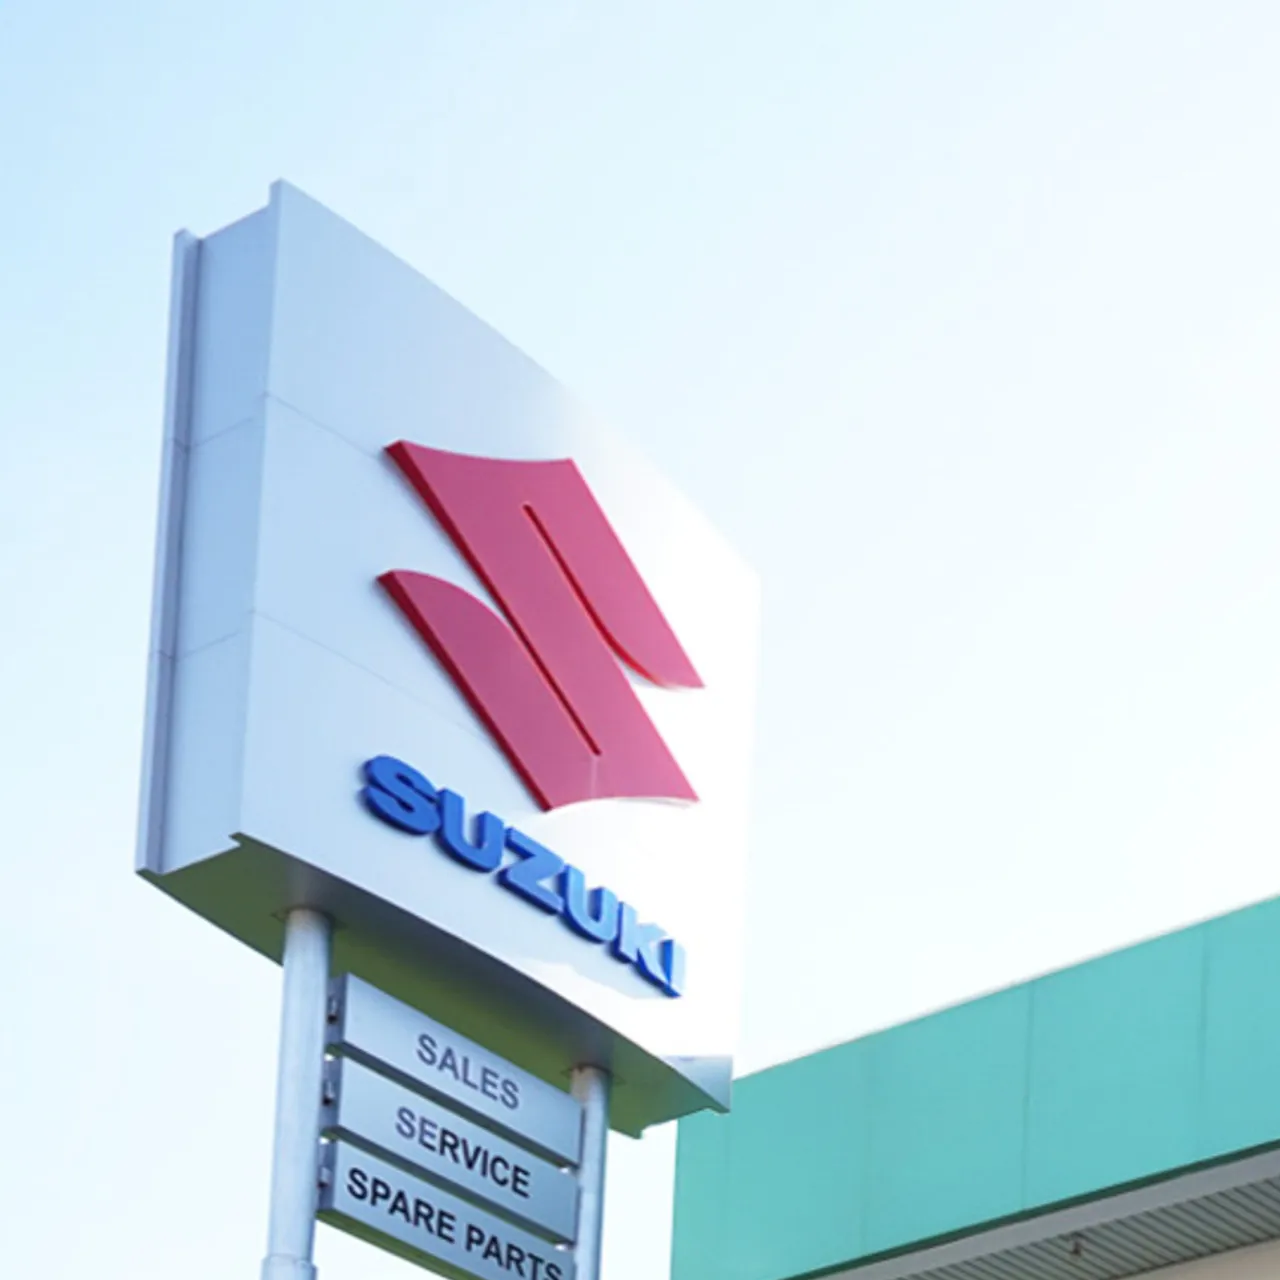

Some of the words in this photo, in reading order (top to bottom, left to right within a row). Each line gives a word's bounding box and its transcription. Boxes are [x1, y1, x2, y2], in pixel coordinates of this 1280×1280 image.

[361, 755, 684, 998] SUZUKI
[416, 1034, 520, 1109] SALES
[395, 1107, 531, 1198] SERVICE
[347, 1168, 456, 1242] SPARE
